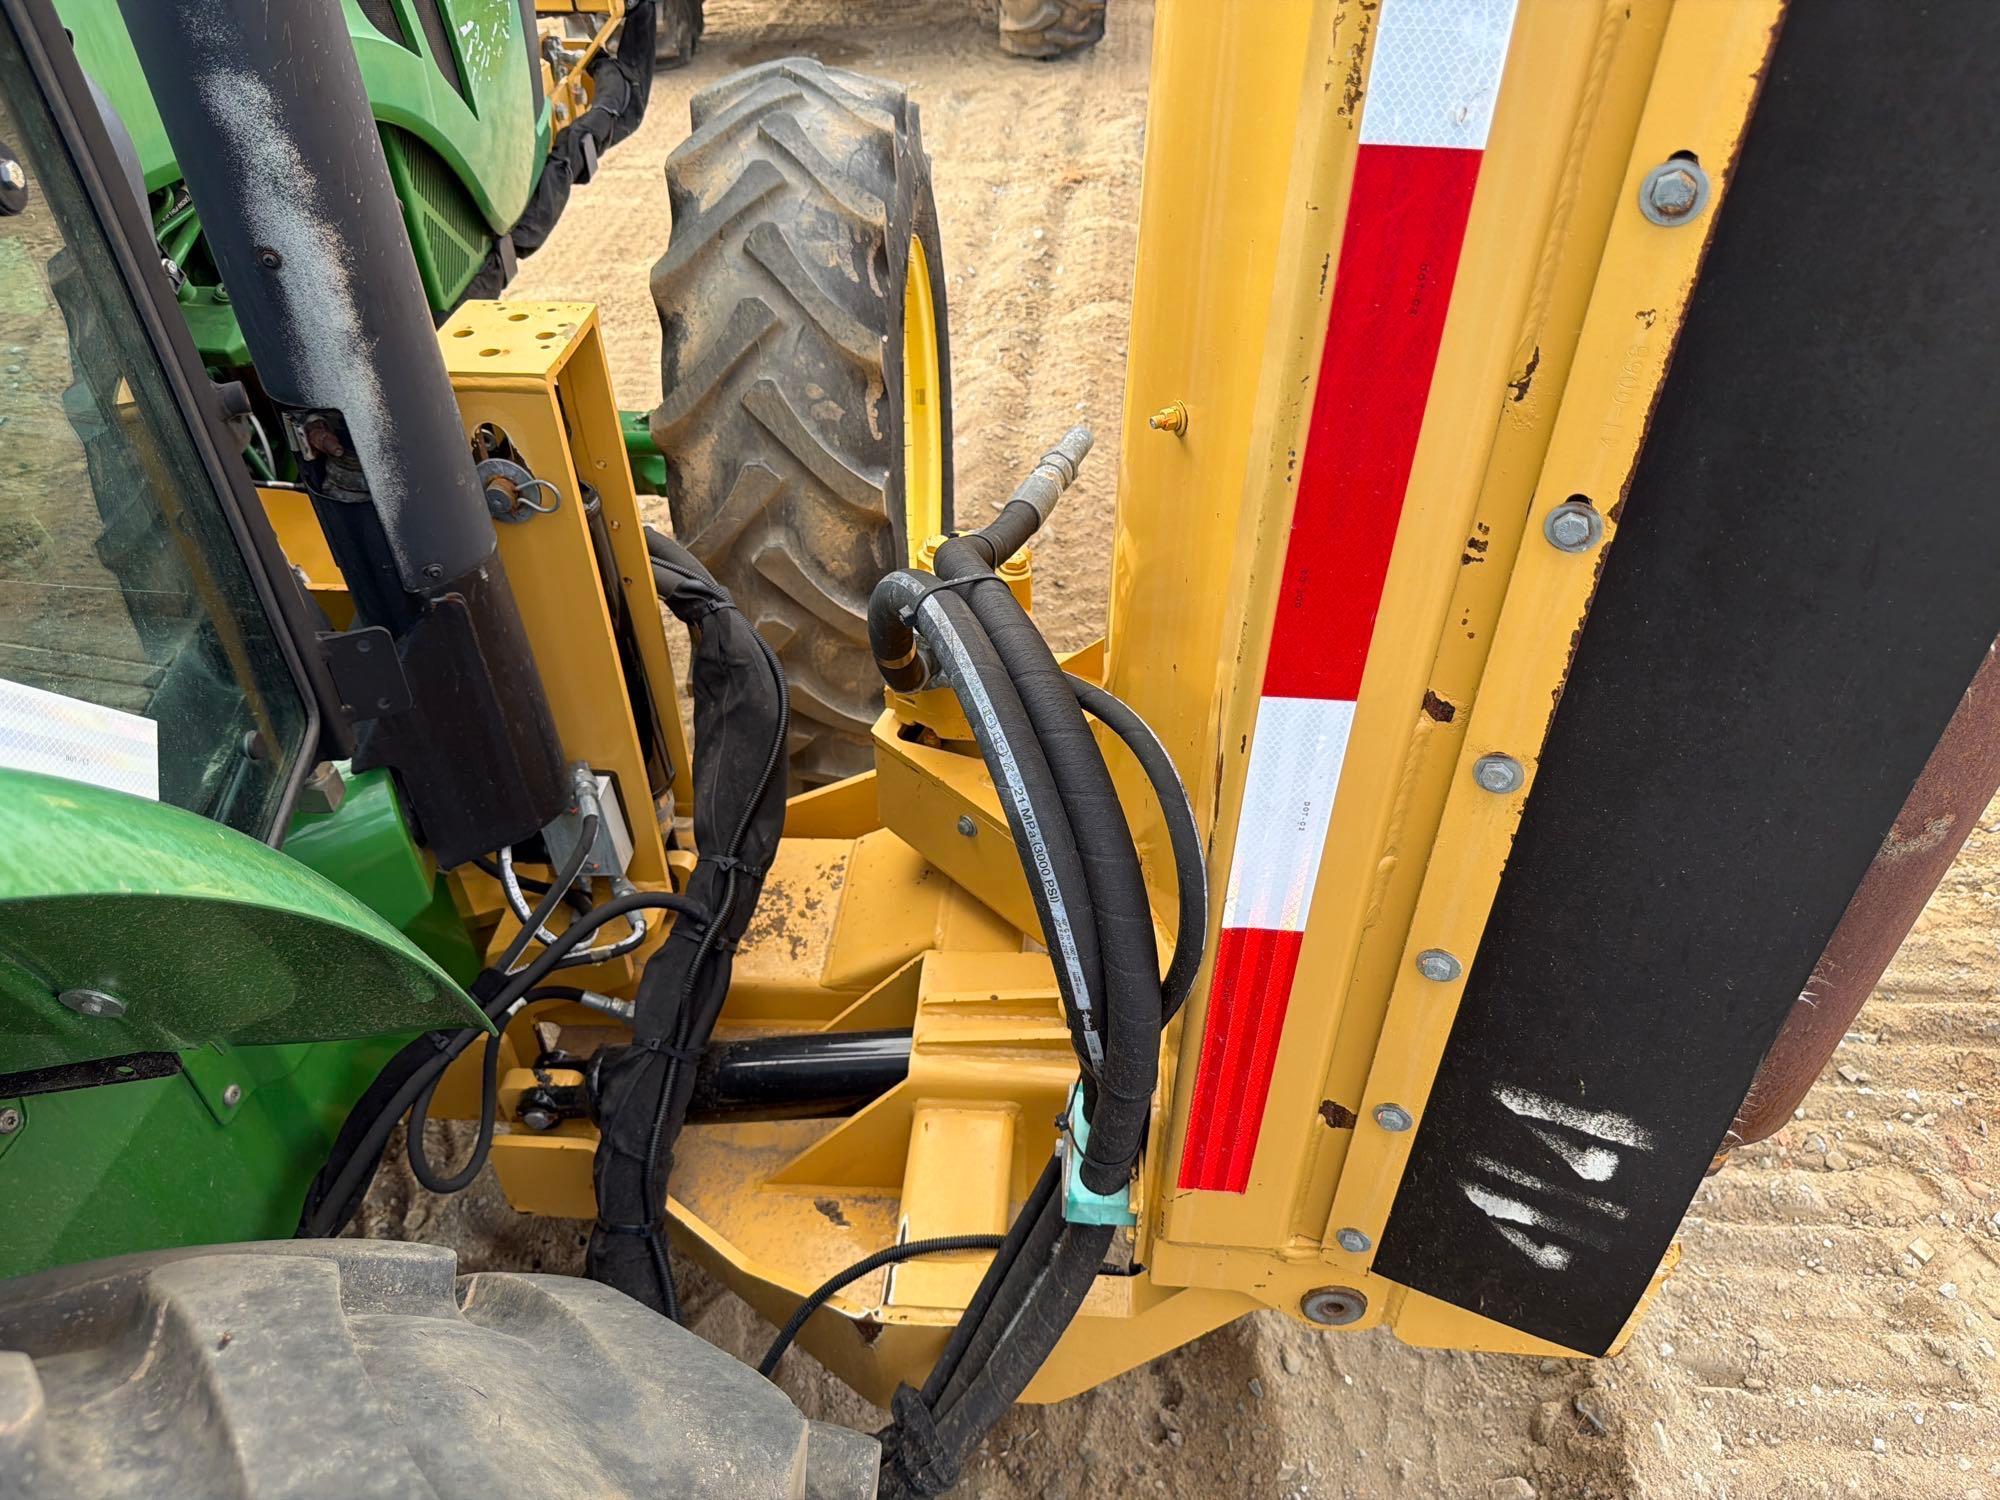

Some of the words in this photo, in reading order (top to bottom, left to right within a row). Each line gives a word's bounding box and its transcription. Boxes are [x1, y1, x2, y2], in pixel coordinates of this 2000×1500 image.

[1014, 787, 1026, 804] 21
[1021, 808, 1038, 839] MPa
[1032, 841, 1051, 876] (3000
[1044, 878, 1061, 904] PSI)
